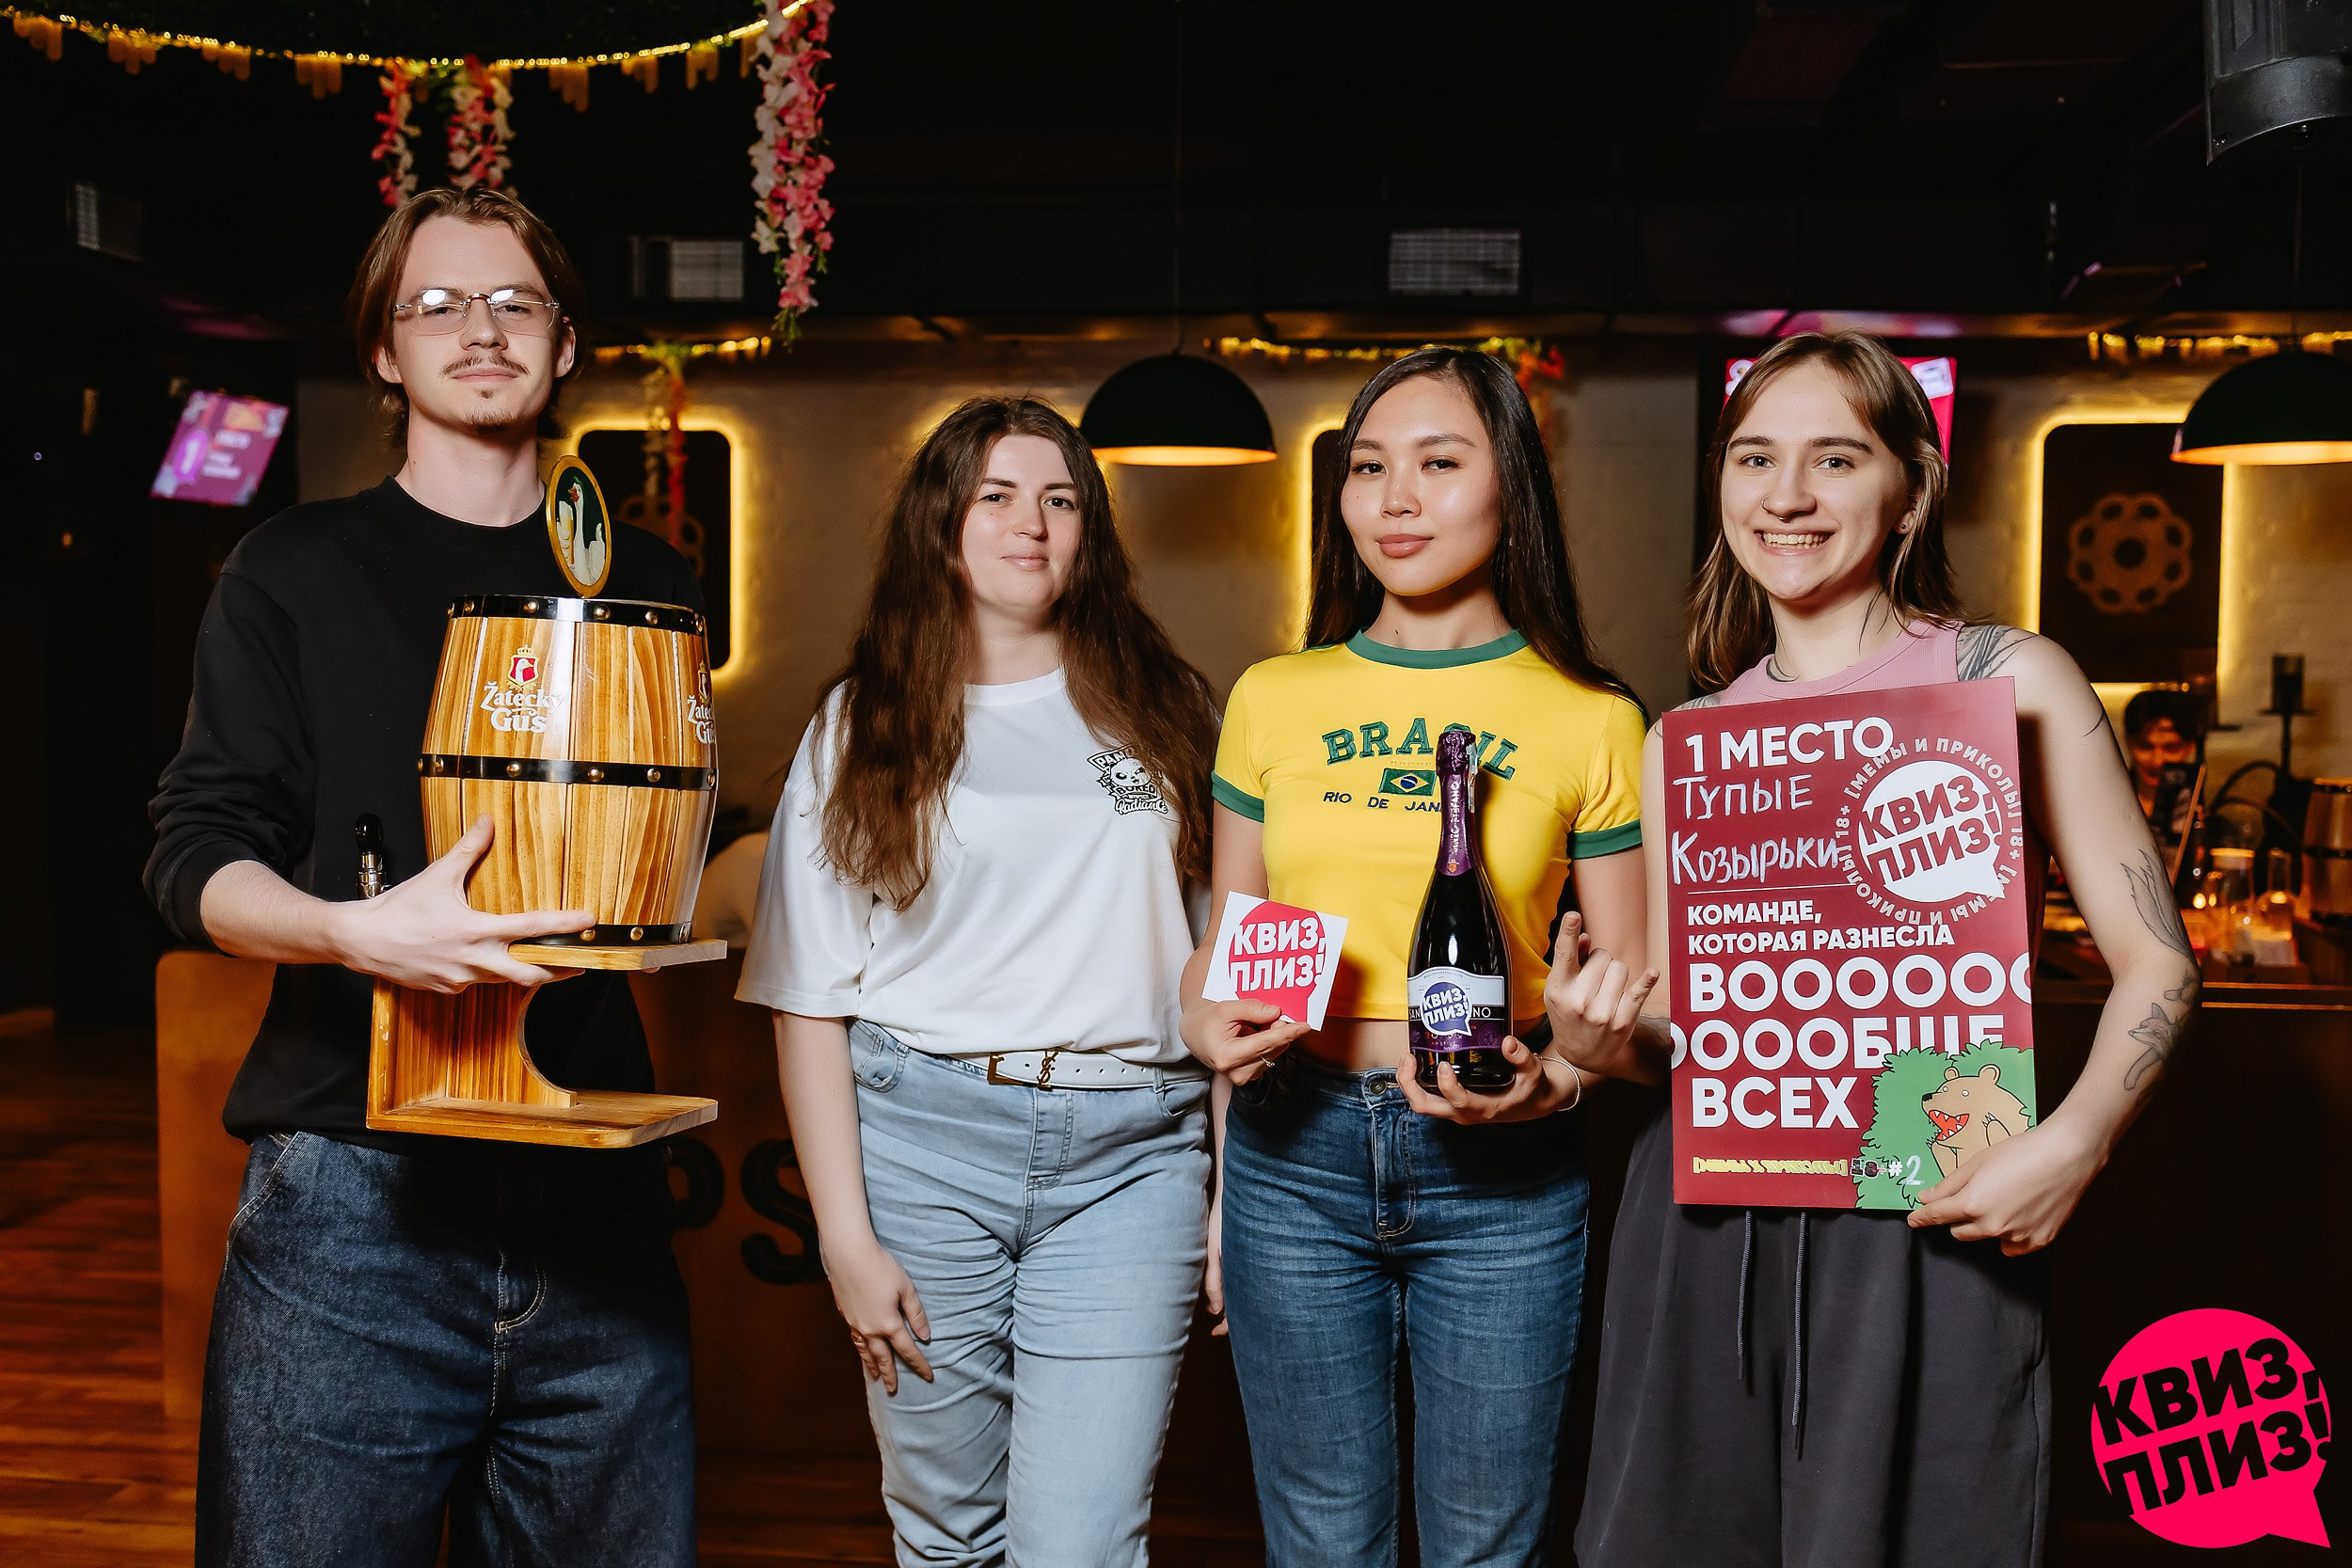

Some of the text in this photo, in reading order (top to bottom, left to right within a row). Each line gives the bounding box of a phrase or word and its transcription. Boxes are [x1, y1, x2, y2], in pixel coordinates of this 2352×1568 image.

[1322, 718, 1518, 781] BRAIL
[1685, 717, 1895, 772] 1 МЕСТО
[1915, 737, 1928, 752] И
[1323, 791, 1442, 813] RIO DE JAN
[1867, 811, 2004, 886] ПЛИЗ!
[1687, 899, 1822, 927] КОМАНДЕ,
[1687, 924, 1956, 956] КОТОРАЯ РАЗНЕСЛА
[1230, 953, 1325, 992] ПЛИЗ!
[1692, 1076, 1859, 1130] ВСЕХ
